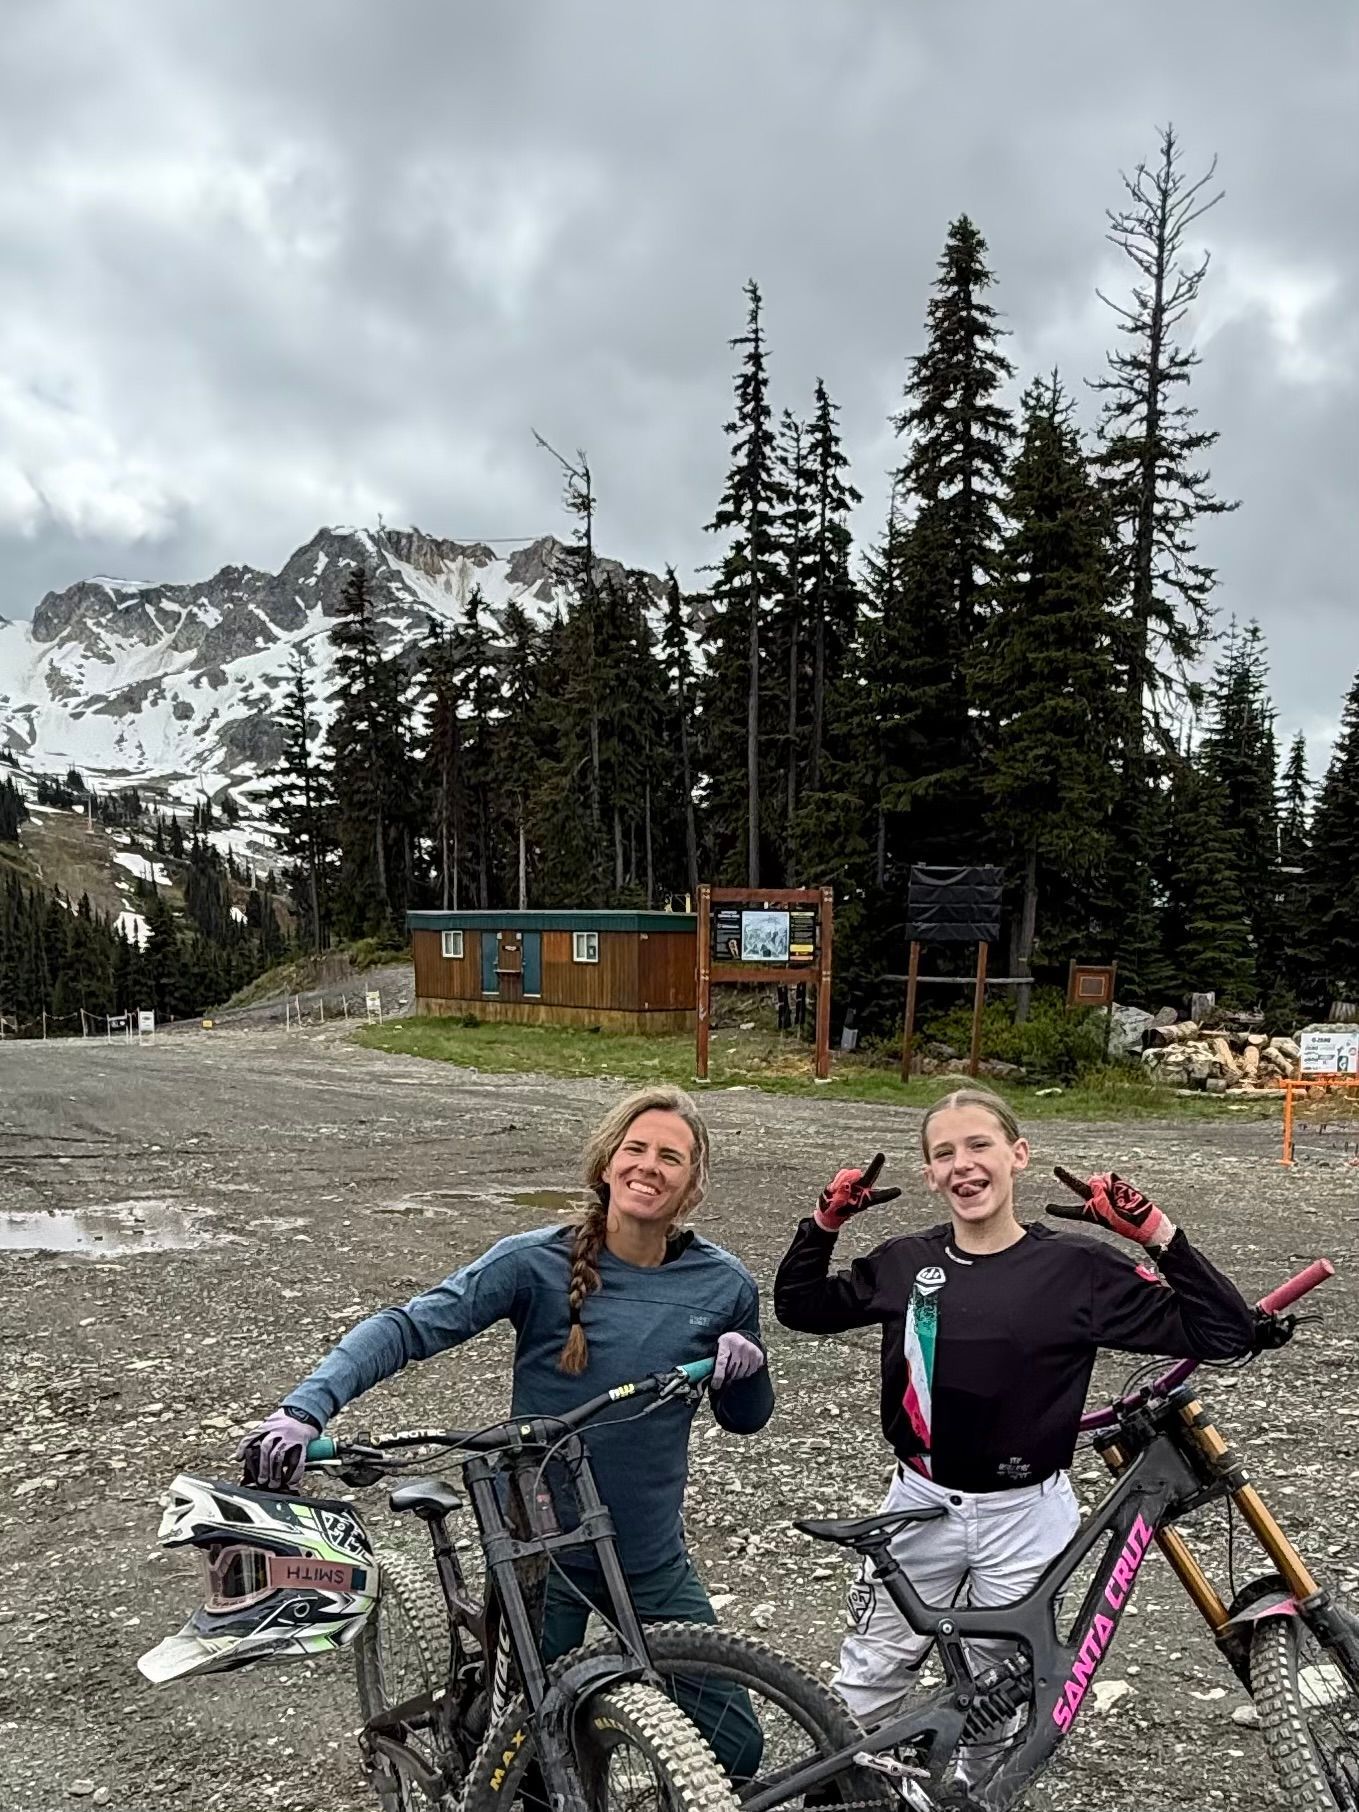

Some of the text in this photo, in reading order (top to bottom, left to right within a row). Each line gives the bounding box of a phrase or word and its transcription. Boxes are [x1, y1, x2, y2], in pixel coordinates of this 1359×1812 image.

[287, 1566, 345, 1585] SMITH
[1052, 1513, 1153, 1734] SANTA CRUZ
[489, 1729, 527, 1792] MAX
